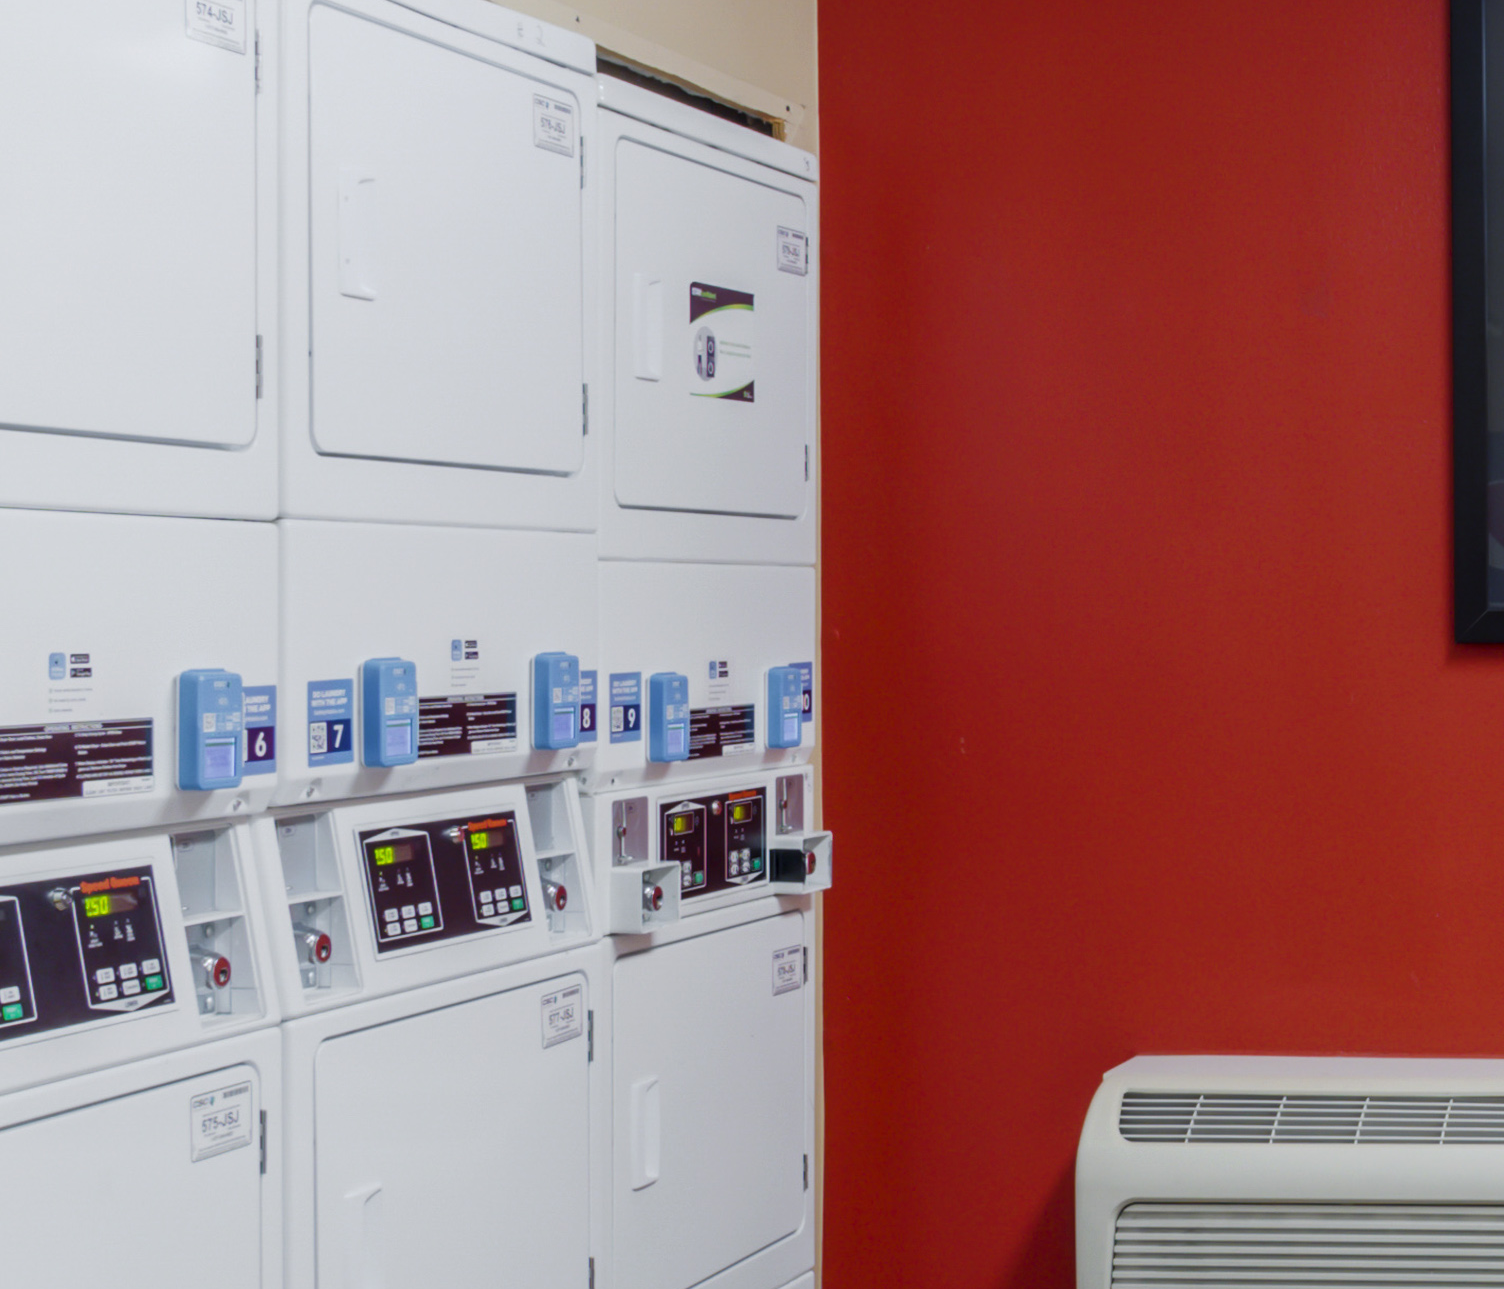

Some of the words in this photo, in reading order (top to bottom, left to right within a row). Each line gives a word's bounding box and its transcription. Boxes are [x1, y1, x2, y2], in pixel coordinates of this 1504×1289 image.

[583, 708, 591, 729] 8
[628, 708, 636, 729] 9
[255, 732, 267, 757] 6
[333, 724, 344, 748] 7
